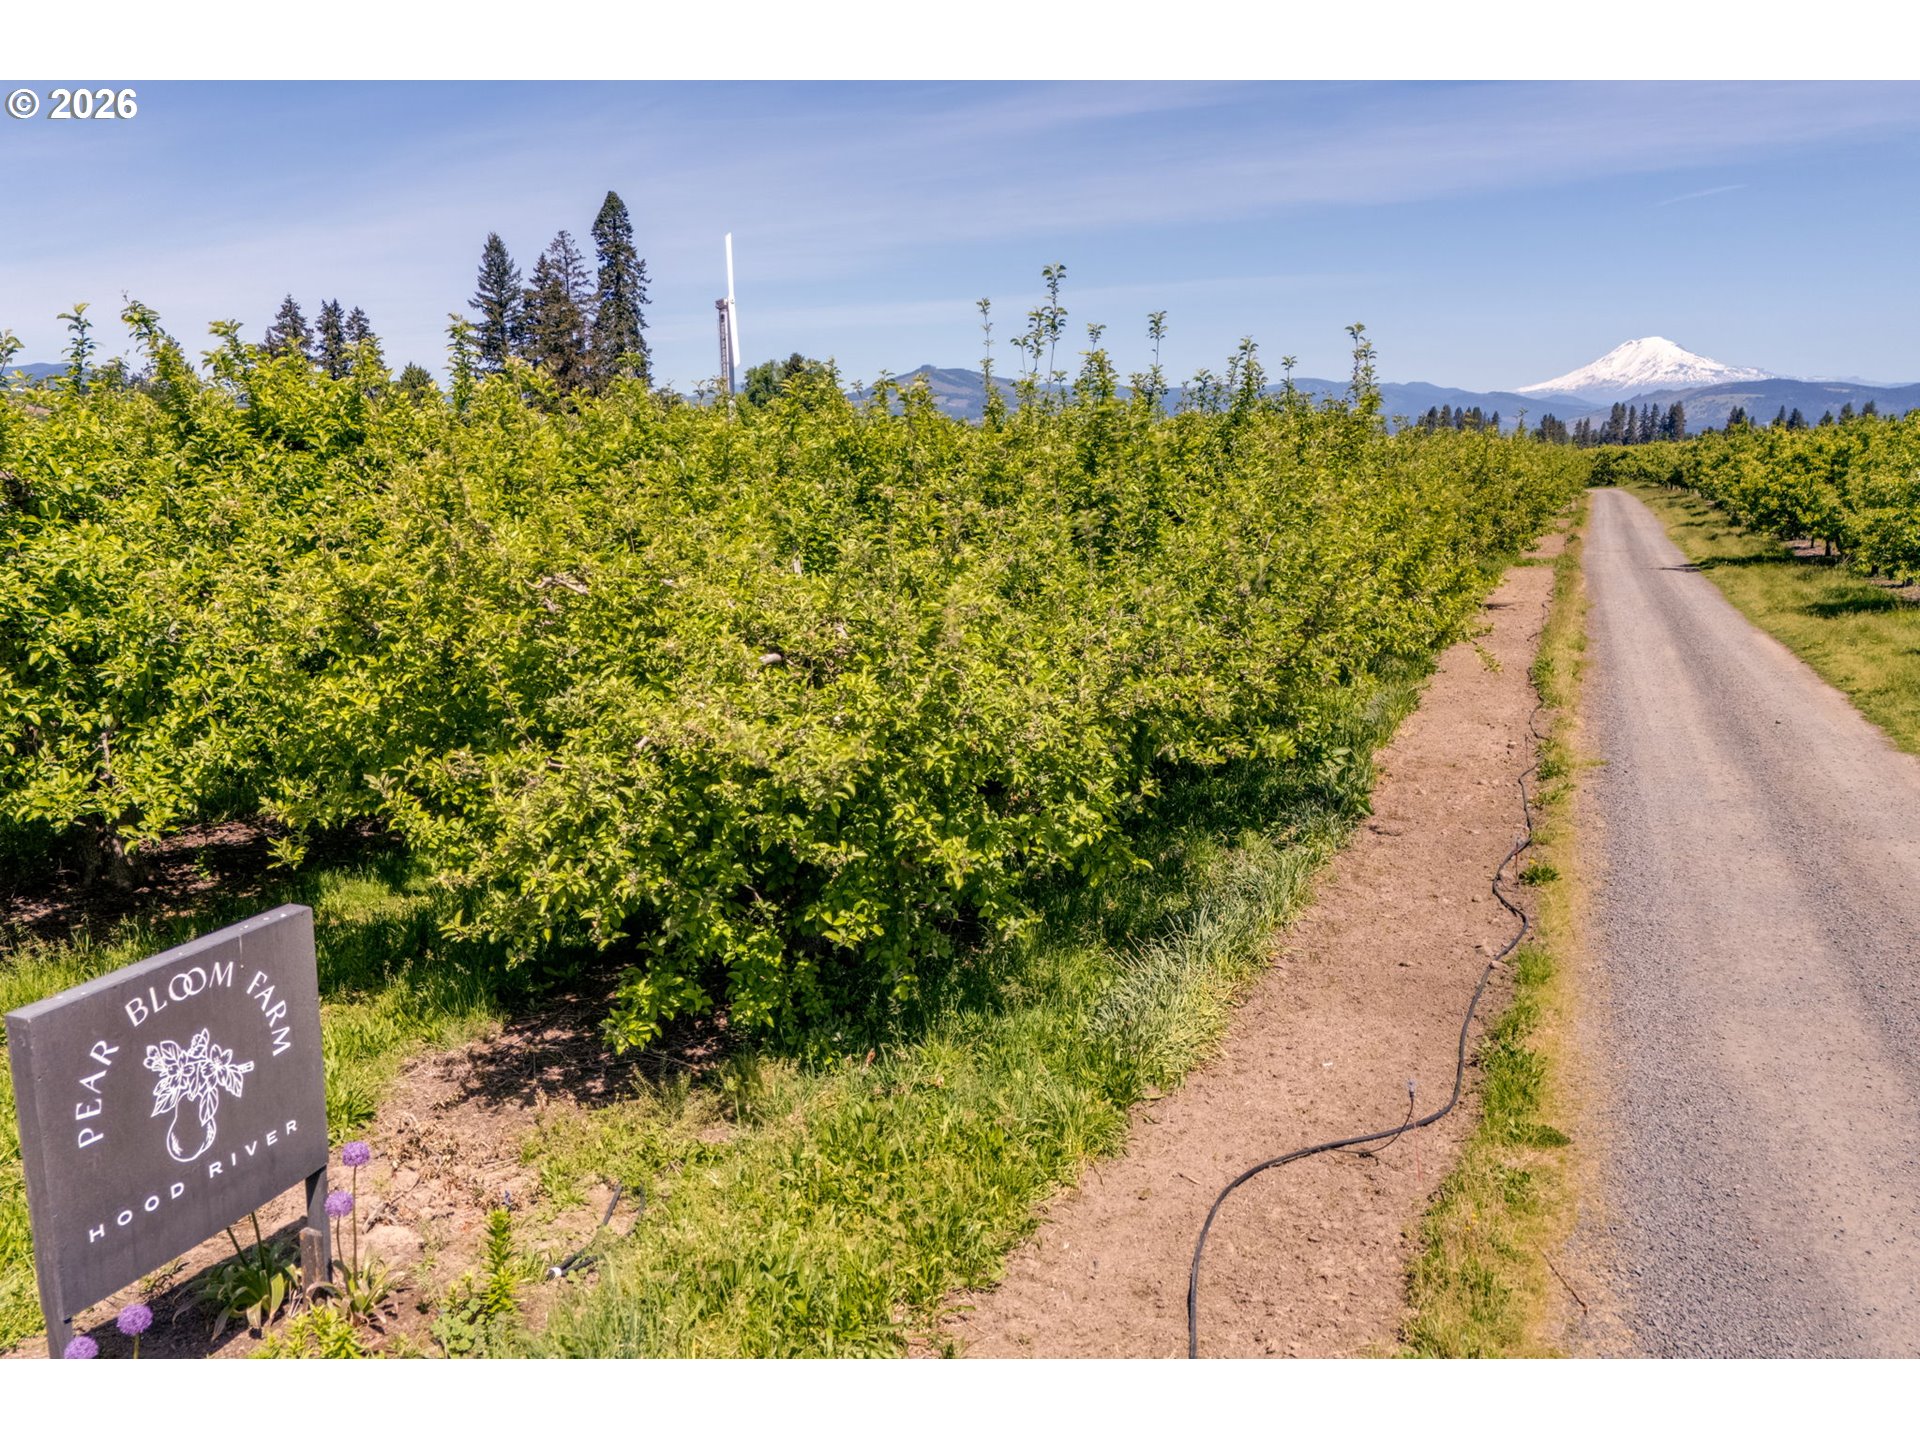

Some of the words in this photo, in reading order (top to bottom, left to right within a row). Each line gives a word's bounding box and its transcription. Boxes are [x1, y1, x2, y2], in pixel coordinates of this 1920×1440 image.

[75, 1040, 119, 1149] PEAR
[124, 961, 234, 1027] BLOOM
[246, 970, 291, 1056] FARM
[88, 1181, 185, 1243] HOOD
[208, 1119, 298, 1178] RIVER
